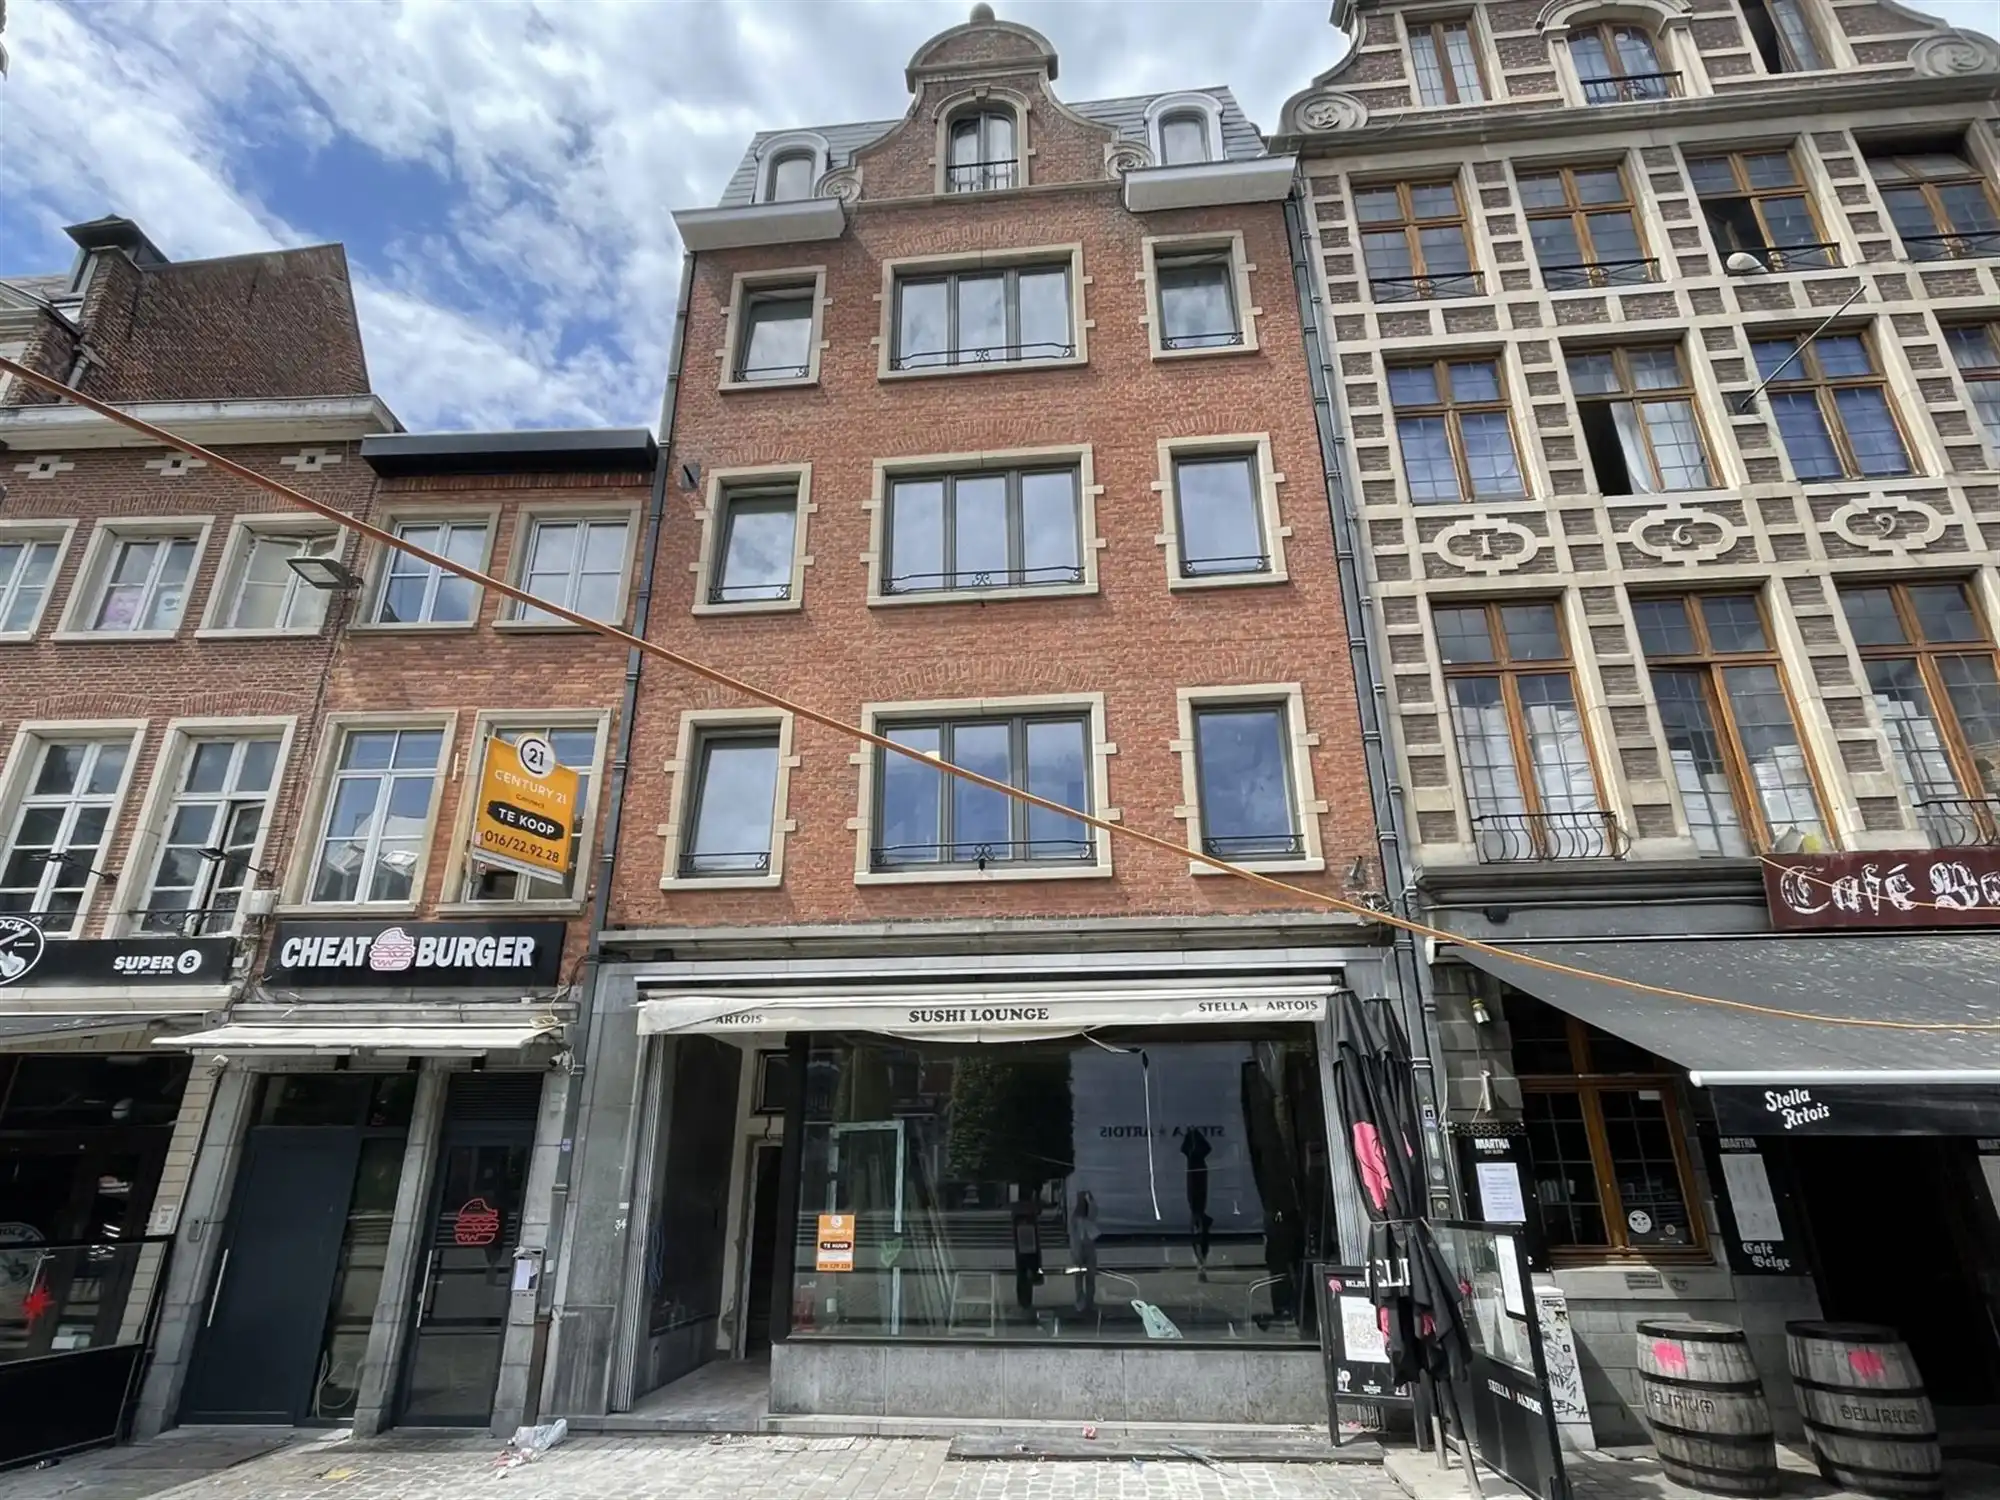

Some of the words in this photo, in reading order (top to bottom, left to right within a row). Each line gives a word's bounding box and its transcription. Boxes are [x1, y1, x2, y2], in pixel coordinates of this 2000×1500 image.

[1477, 533, 1493, 555] 1
[1672, 524, 1693, 545] 6
[1875, 512, 1896, 538] 9
[528, 748, 545, 766] 21
[494, 769, 554, 798] CENTURY
[556, 792, 567, 805] 21
[498, 808, 515, 823] TE
[519, 814, 555, 836] KOOP
[484, 830, 560, 863] 016/22.92.28
[1780, 863, 1918, 916] Café
[280, 936, 372, 968] CHEAT
[415, 936, 536, 968] BURGER
[113, 955, 175, 971] SUPER
[908, 1010, 966, 1023] SUSHI
[971, 1008, 1050, 1022] LOUNGE
[1198, 1002, 1249, 1013] STELLA
[1266, 1000, 1319, 1011] ARTOIS
[714, 1014, 765, 1025] ARTOIS
[1764, 1088, 1811, 1112] Stella
[1781, 1102, 1830, 1129] Artois
[615, 1219, 627, 1230] 34
[1742, 1242, 1774, 1257] Café
[1751, 1255, 1791, 1271] Belge
